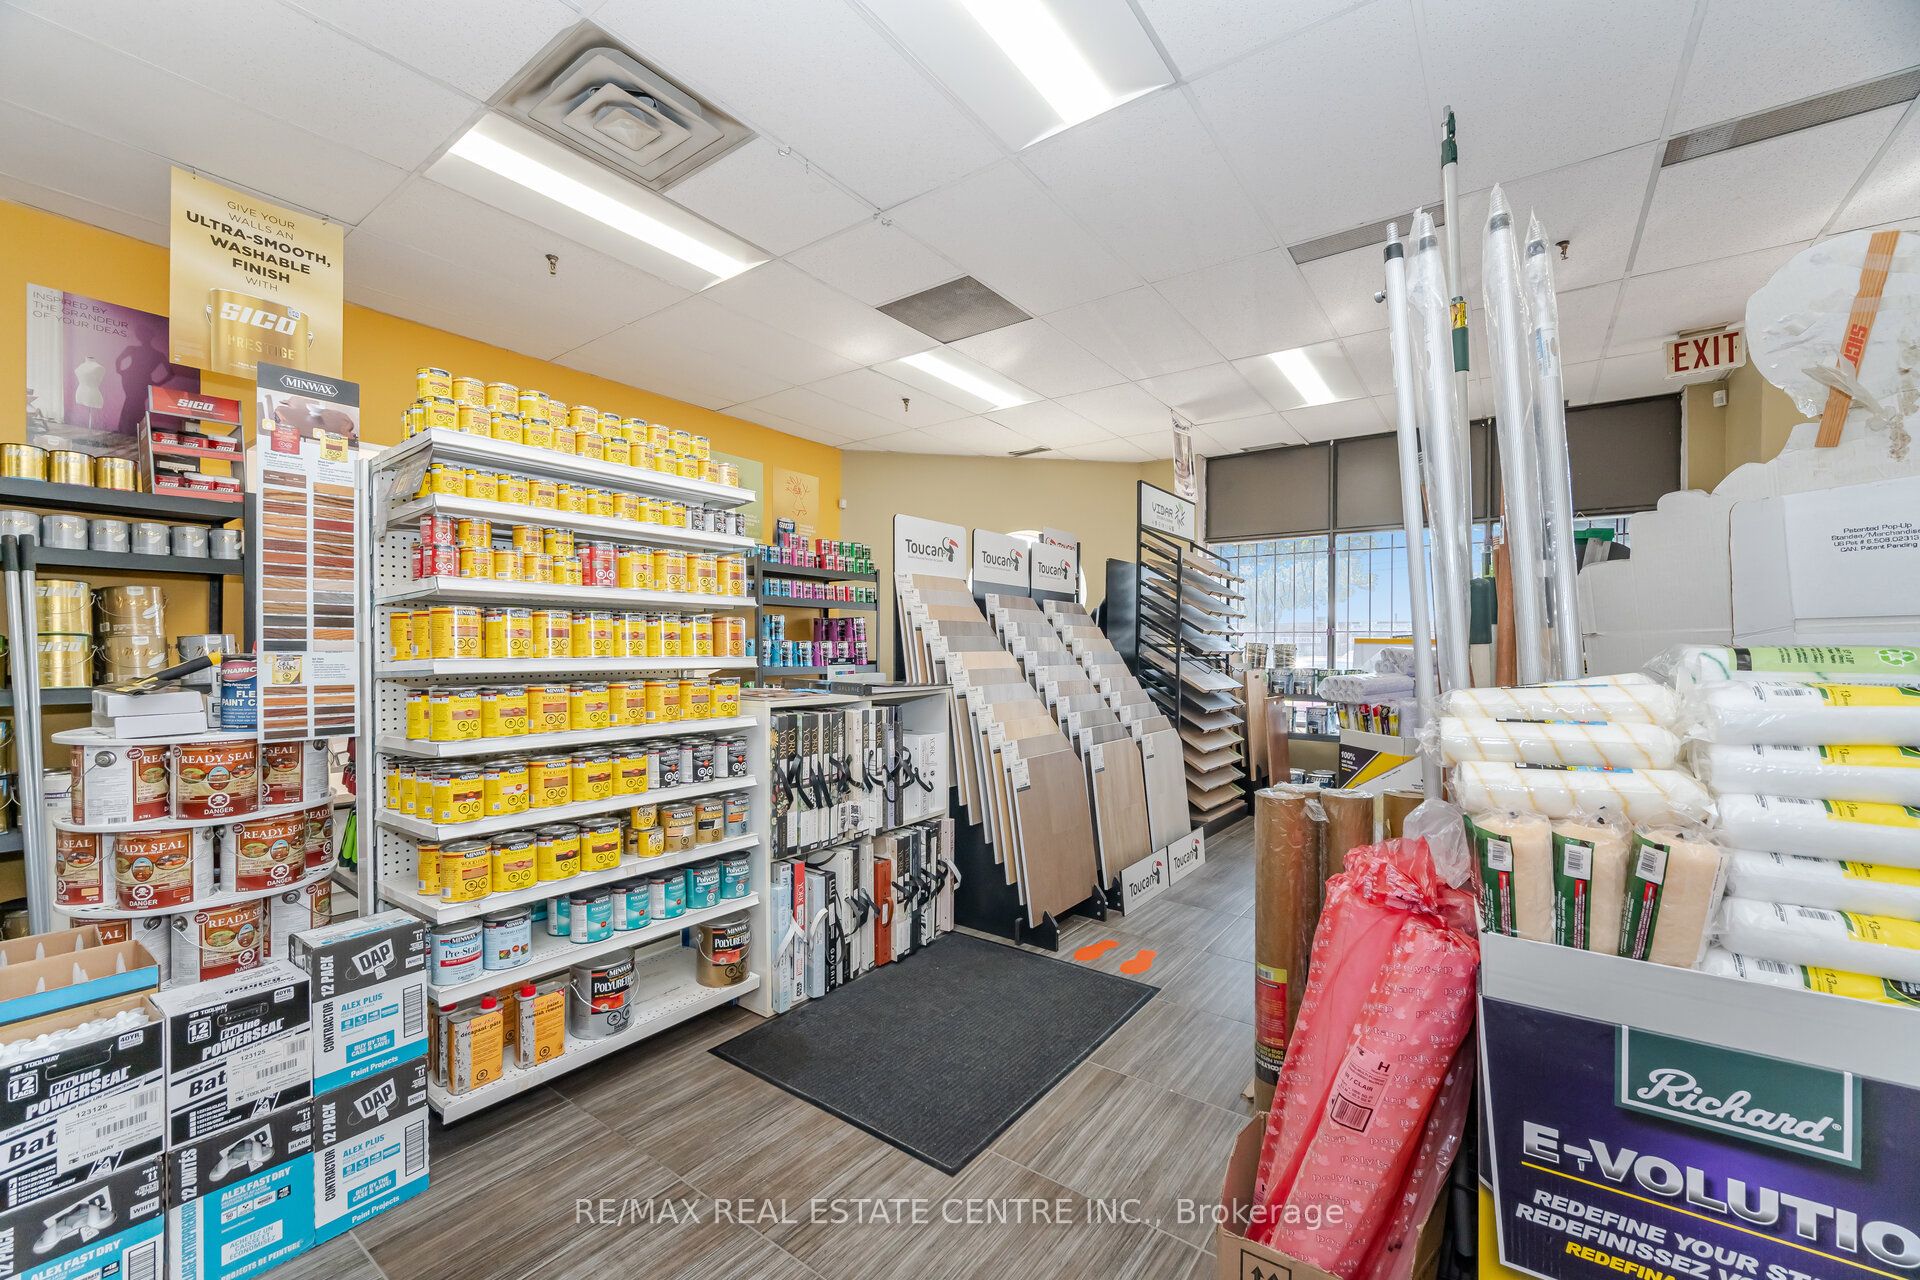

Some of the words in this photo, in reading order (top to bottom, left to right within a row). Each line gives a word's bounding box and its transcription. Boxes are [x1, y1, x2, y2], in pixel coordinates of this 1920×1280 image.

[227, 201, 257, 218] GIVE
[261, 212, 295, 230] YOUR
[229, 213, 272, 234] WALLS
[277, 229, 294, 240] AN
[186, 210, 331, 267] ULTRA-SMOOTH,
[210, 234, 310, 274] WASHABLE
[233, 258, 290, 283] FINISH
[245, 276, 278, 292] WITH
[33, 291, 88, 310] INSPIRED
[93, 305, 108, 314] BY
[33, 301, 56, 311] THE
[62, 308, 128, 329] GRANDEUR
[220, 302, 296, 336] SICO
[56, 315, 89, 328] YOUR
[93, 324, 127, 337] IDEAS
[1674, 332, 1739, 372] EXIT
[286, 378, 334, 394] MINWAX
[176, 398, 215, 411] SICO
[1152, 502, 1173, 517] VIDAR
[1843, 525, 1879, 533] Patented
[1882, 522, 1912, 530] Pop-Up
[905, 538, 944, 557] Toucan
[982, 550, 1011, 567] Toucan
[1038, 561, 1062, 576] Toucan
[788, 728, 796, 755] YORK
[181, 754, 224, 763] READY
[228, 751, 254, 762] SEAL
[1341, 751, 1356, 760] 100%
[204, 807, 234, 815] DANGER
[243, 828, 284, 839] READY
[63, 840, 92, 848] SEAL
[150, 840, 185, 851] SEAL
[1173, 851, 1194, 870] Toucan
[267, 877, 293, 887] DANGER
[1129, 875, 1155, 897] Toucan
[209, 911, 250, 928] READY
[359, 944, 391, 971] DAP
[235, 961, 258, 973] DANGER
[320, 955, 334, 982] PACK
[609, 964, 633, 976] MINWAX
[320, 982, 335, 998] 12
[200, 1004, 228, 1015] TOOLWAY
[341, 999, 361, 1012] ALEX
[363, 993, 383, 1005] PLUS
[189, 1022, 209, 1038] 12
[221, 1019, 261, 1041] ProLine
[323, 1001, 334, 1053] CONTRACTOR
[191, 1032, 209, 1042] PACK
[202, 1019, 283, 1061] POWERSEAL
[24, 1054, 60, 1069] TOOLWAY
[240, 1050, 266, 1062] 123125
[351, 1064, 369, 1078] Paint
[370, 1055, 399, 1071] Projects
[1377, 1061, 1390, 1072] H
[10, 1076, 35, 1094] 12
[51, 1069, 101, 1095] ProLine
[189, 1071, 228, 1098] Bat
[1353, 1079, 1374, 1092] CLAIR
[12, 1088, 37, 1100] PACK
[25, 1067, 129, 1120] POWERSEAL
[247, 1086, 272, 1098] TOOLWAY
[361, 1084, 394, 1115] DAP
[76, 1103, 108, 1118] 123126
[1636, 1068, 1834, 1143] Richard
[322, 1102, 336, 1130] PACK
[8, 1128, 58, 1163] Bat
[290, 1139, 310, 1149] BLANC
[323, 1131, 336, 1146] 12
[343, 1142, 363, 1158] ALEX
[365, 1135, 385, 1148] PLUS
[82, 1144, 115, 1160] TOOLWAY
[221, 1184, 247, 1202] ALEX
[247, 1177, 271, 1192] FAST
[271, 1166, 292, 1181] DRY
[325, 1149, 336, 1202] CONTRACTOR
[181, 1185, 198, 1201] 12
[132, 1201, 155, 1214] WHITE
[352, 1208, 370, 1224] Paint
[371, 1196, 400, 1214] Projects
[1533, 1189, 1667, 1244] REDEFINE
[1674, 1232, 1760, 1275] YOUR
[1516, 1203, 1711, 1280] REDEFINISSEZ
[31, 1260, 62, 1280] ALEX
[63, 1251, 95, 1270] FAST
[96, 1239, 121, 1255] DRY
[258, 1256, 267, 1266] DE
